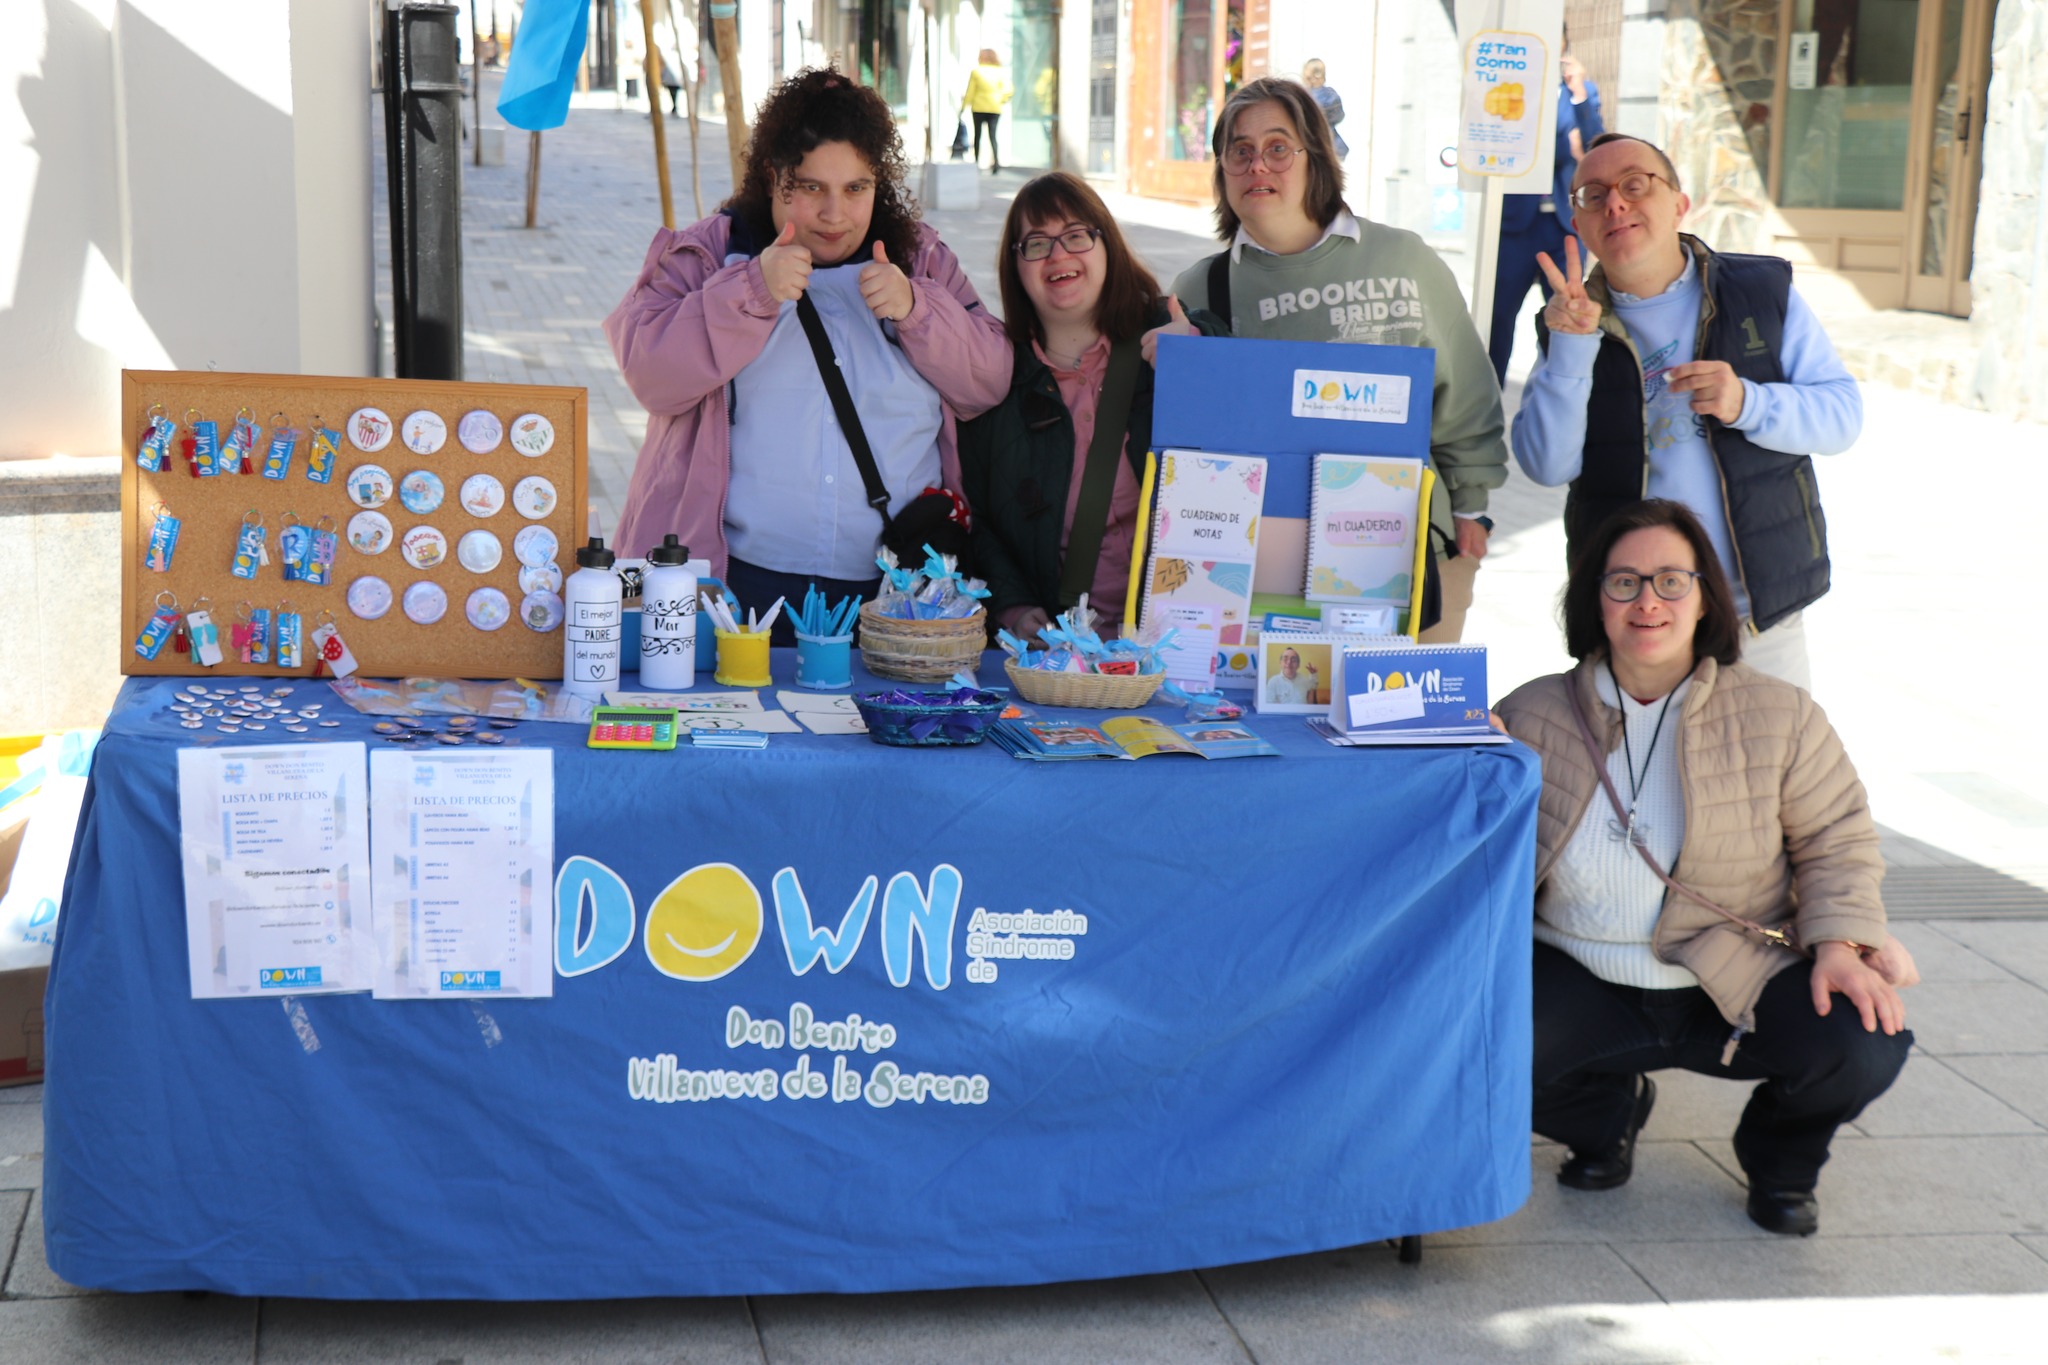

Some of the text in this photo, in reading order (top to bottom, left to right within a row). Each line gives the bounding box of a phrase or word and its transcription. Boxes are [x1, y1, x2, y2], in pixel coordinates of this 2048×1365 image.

[1477, 41, 1527, 56] #Tan
[1475, 56, 1527, 71] Como
[1474, 69, 1498, 82] Tú
[1258, 277, 1420, 322] BROOKLYN
[1329, 300, 1423, 326] BRIDGE
[1741, 317, 1766, 350] 1
[1304, 380, 1378, 406] DOWN
[195, 434, 213, 476] DOWN
[264, 440, 288, 479] DOWN
[1180, 508, 1240, 524] CUADERNO DE
[1193, 528, 1223, 540] NOTAS
[580, 609, 613, 622] El mejor
[654, 617, 680, 631] Mar
[136, 616, 167, 656] DOWN
[584, 629, 611, 641] PADRE
[576, 651, 616, 660] del mundo
[1464, 709, 1486, 721] 2025
[222, 790, 328, 804] LISTA DE PRECIOS
[413, 794, 517, 806] LISTA DE PRECIOS
[554, 855, 963, 991] DOWN
[967, 907, 1089, 936] Asociación
[966, 933, 1076, 960] Síndrome
[262, 968, 306, 983] DOWN
[442, 971, 486, 985] DOWN
[966, 958, 999, 984] de
[725, 1002, 898, 1054] Don Benito
[627, 1053, 990, 1109] Villanueva de la Serena
